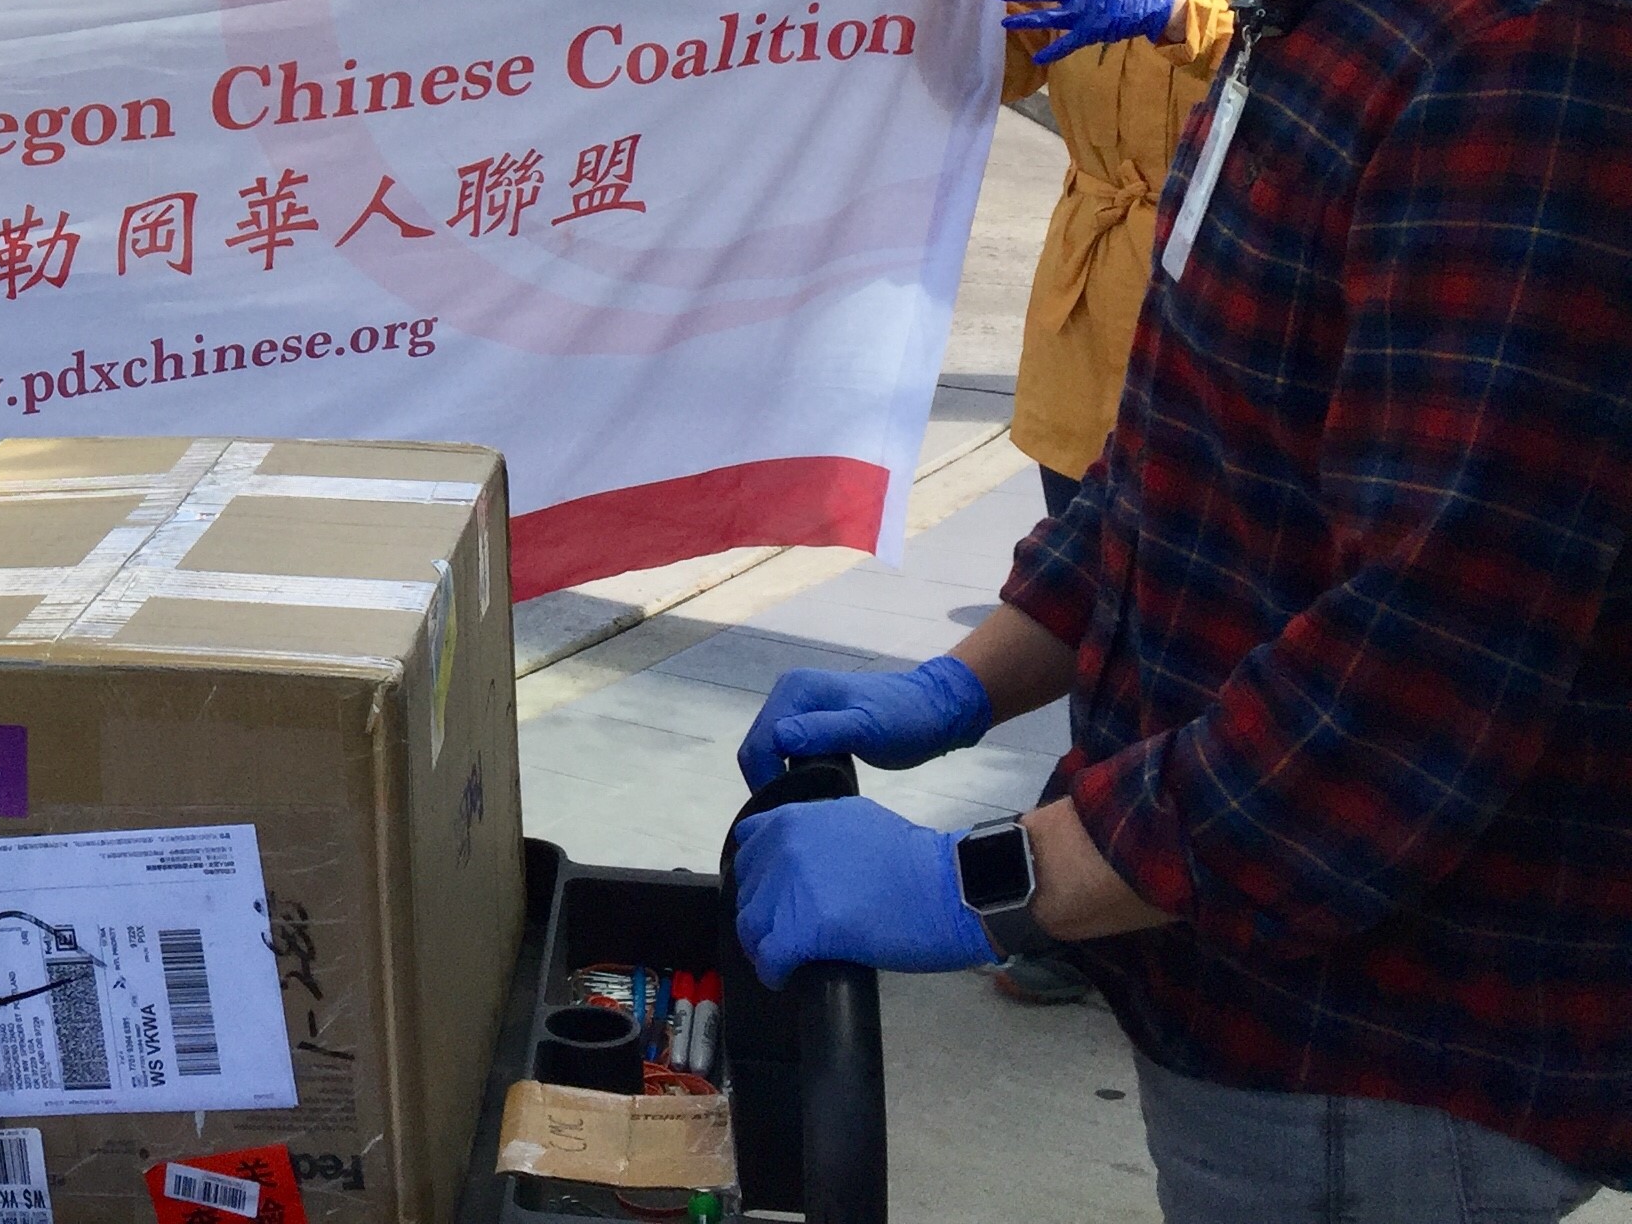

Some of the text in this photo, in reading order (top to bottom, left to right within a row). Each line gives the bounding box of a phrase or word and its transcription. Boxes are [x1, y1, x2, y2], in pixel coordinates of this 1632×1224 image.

[212, 57, 535, 130] Chinese
[566, 3, 916, 92] Coalition
[140, 1003, 162, 1056] VKWA
[148, 1058, 166, 1088] WS
[22, 1188, 47, 1210] WS
